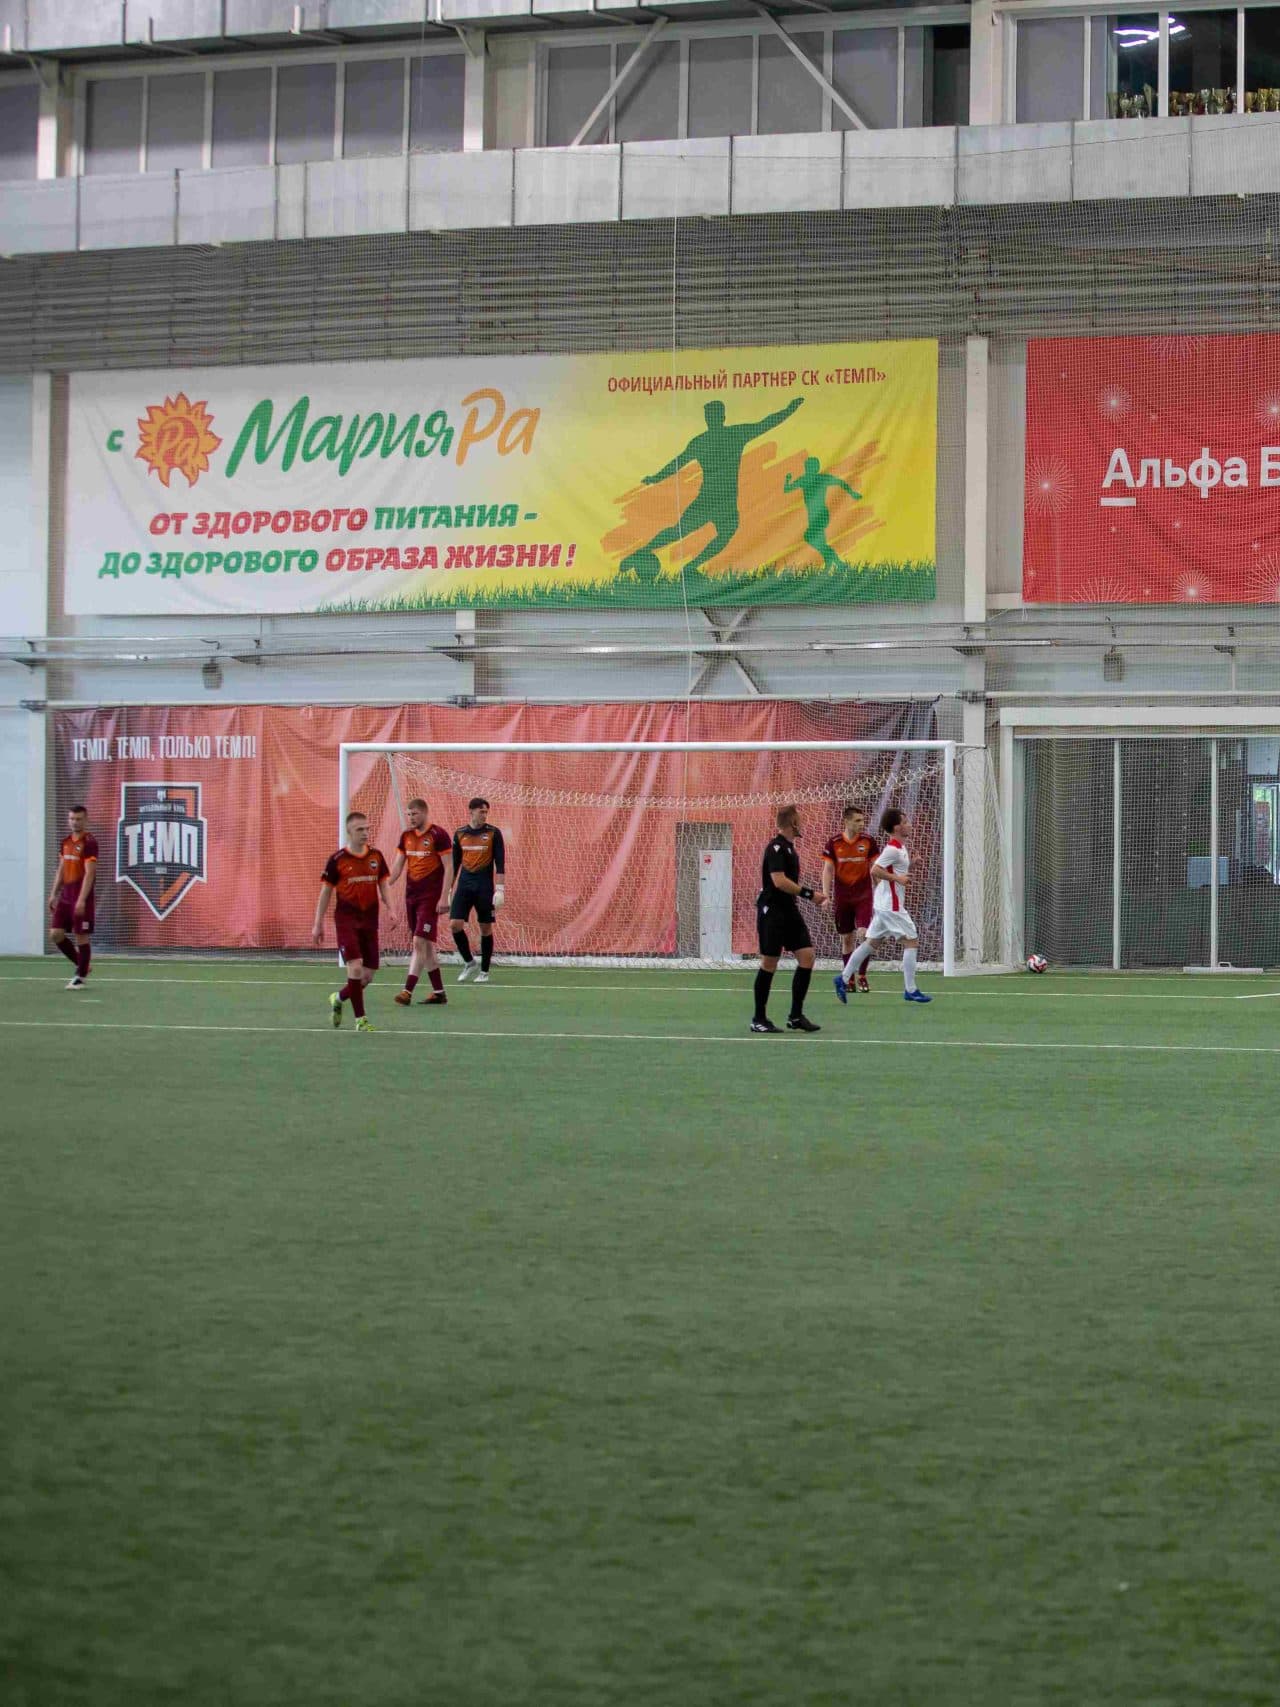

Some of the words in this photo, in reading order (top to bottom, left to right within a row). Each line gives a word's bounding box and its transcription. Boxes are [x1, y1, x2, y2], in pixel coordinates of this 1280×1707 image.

[608, 369, 728, 395] ОФИЦИАЛЬНЫЙ
[733, 370, 797, 388] ПАРТНЕР
[801, 370, 820, 386] СК
[825, 367, 887, 385] «ТЕМП»
[1101, 447, 1249, 500] Альфа
[149, 512, 189, 536] ОТ
[192, 507, 369, 539] ЗДОРОВОГО
[98, 551, 142, 578] ДО
[145, 549, 319, 578] ЗДОРОВОГО
[325, 546, 437, 572] ОБРАЗА
[441, 542, 577, 570] ЖИЗНИ!
[72, 737, 113, 762] ТЕМП,
[115, 736, 155, 761] ТЕМП,
[159, 735, 211, 759] ТОЛЬКО
[215, 735, 256, 759] ТЕМП!
[124, 821, 199, 868] ТЕМП
